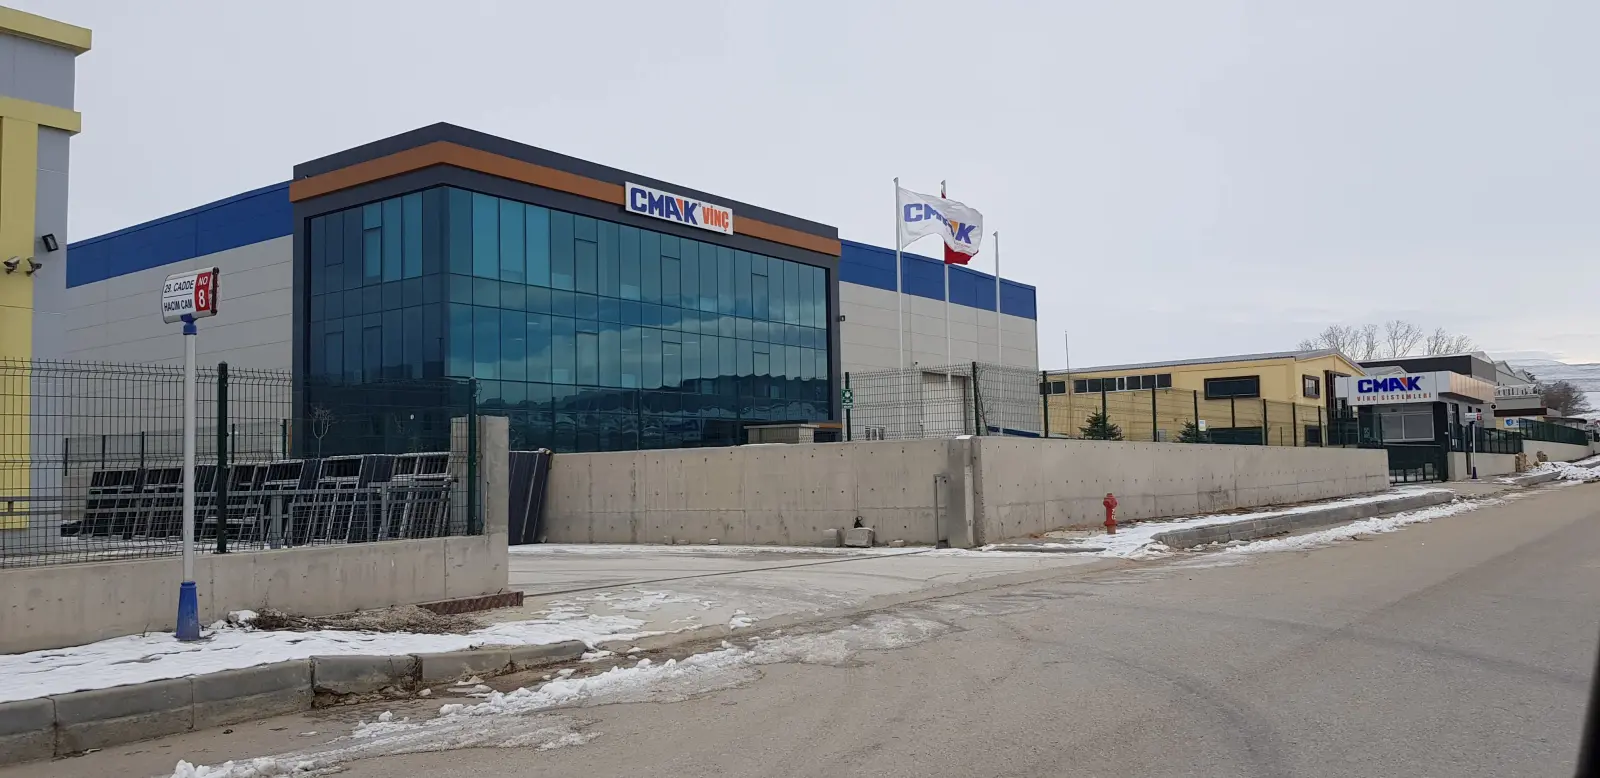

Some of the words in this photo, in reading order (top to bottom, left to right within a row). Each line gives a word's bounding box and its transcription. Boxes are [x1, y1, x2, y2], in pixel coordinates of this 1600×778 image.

[630, 187, 698, 225] CMAK
[174, 280, 194, 291] CADDE
[198, 276, 208, 286] NO
[198, 289, 206, 308] 8
[1358, 376, 1421, 393] CMAK
